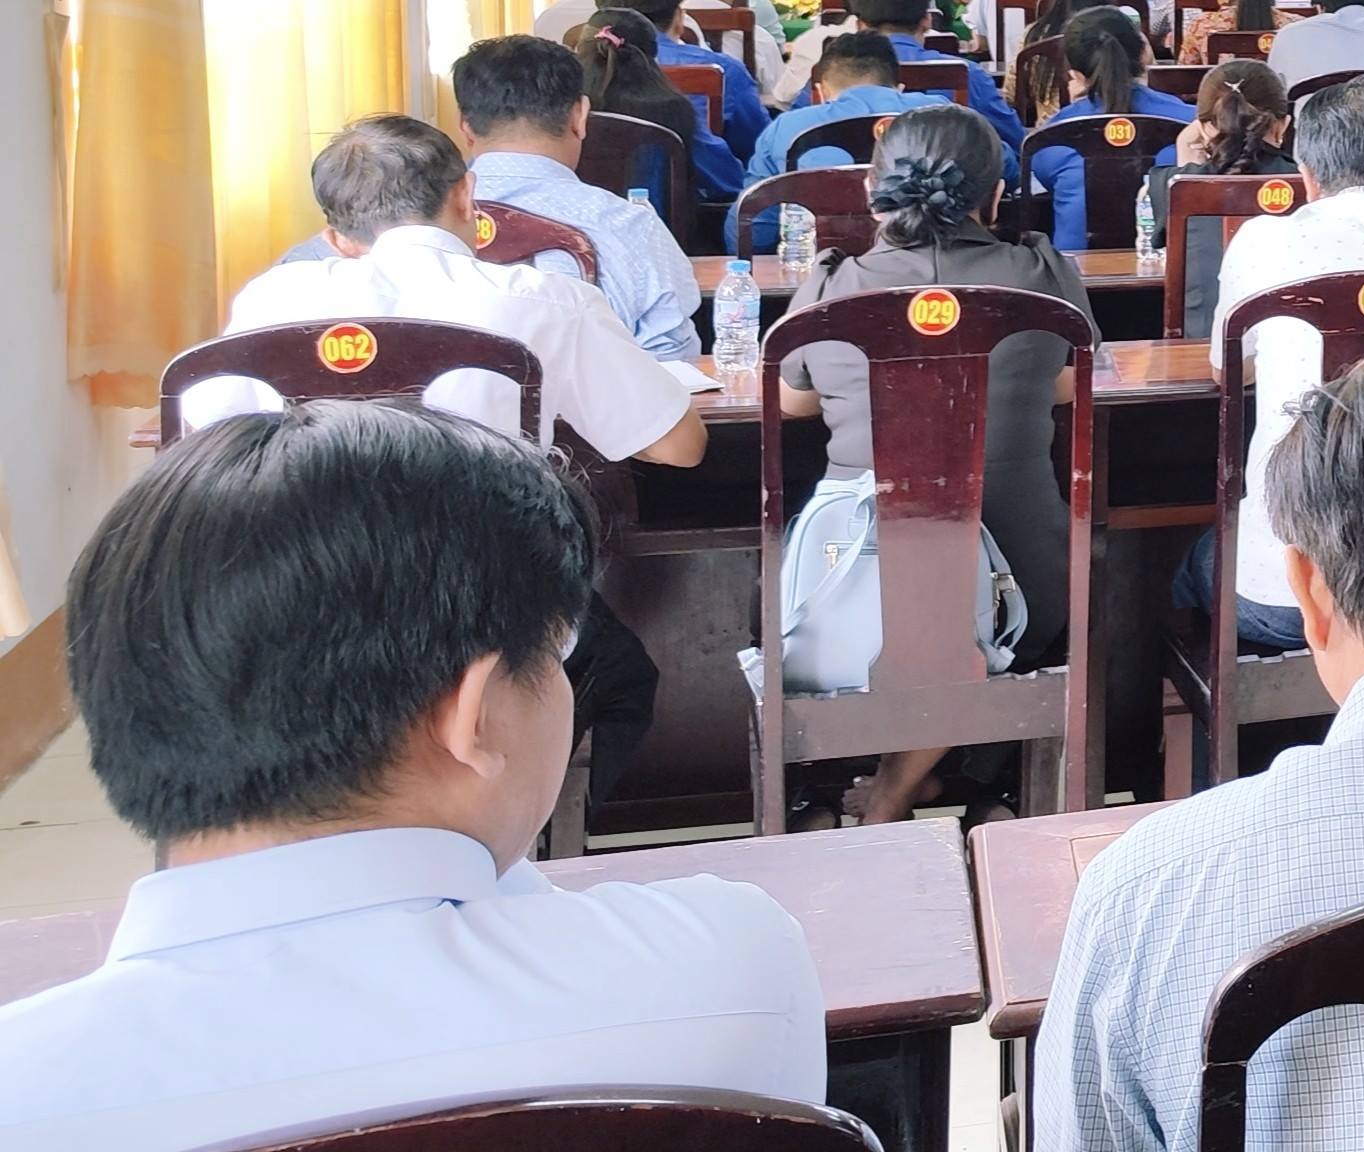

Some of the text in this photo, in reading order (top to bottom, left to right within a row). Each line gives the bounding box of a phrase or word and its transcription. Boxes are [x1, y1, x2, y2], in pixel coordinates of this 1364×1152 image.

[1107, 124, 1131, 140] 031
[1262, 188, 1289, 206] 048
[913, 300, 955, 326] 029
[324, 334, 371, 363] 062
